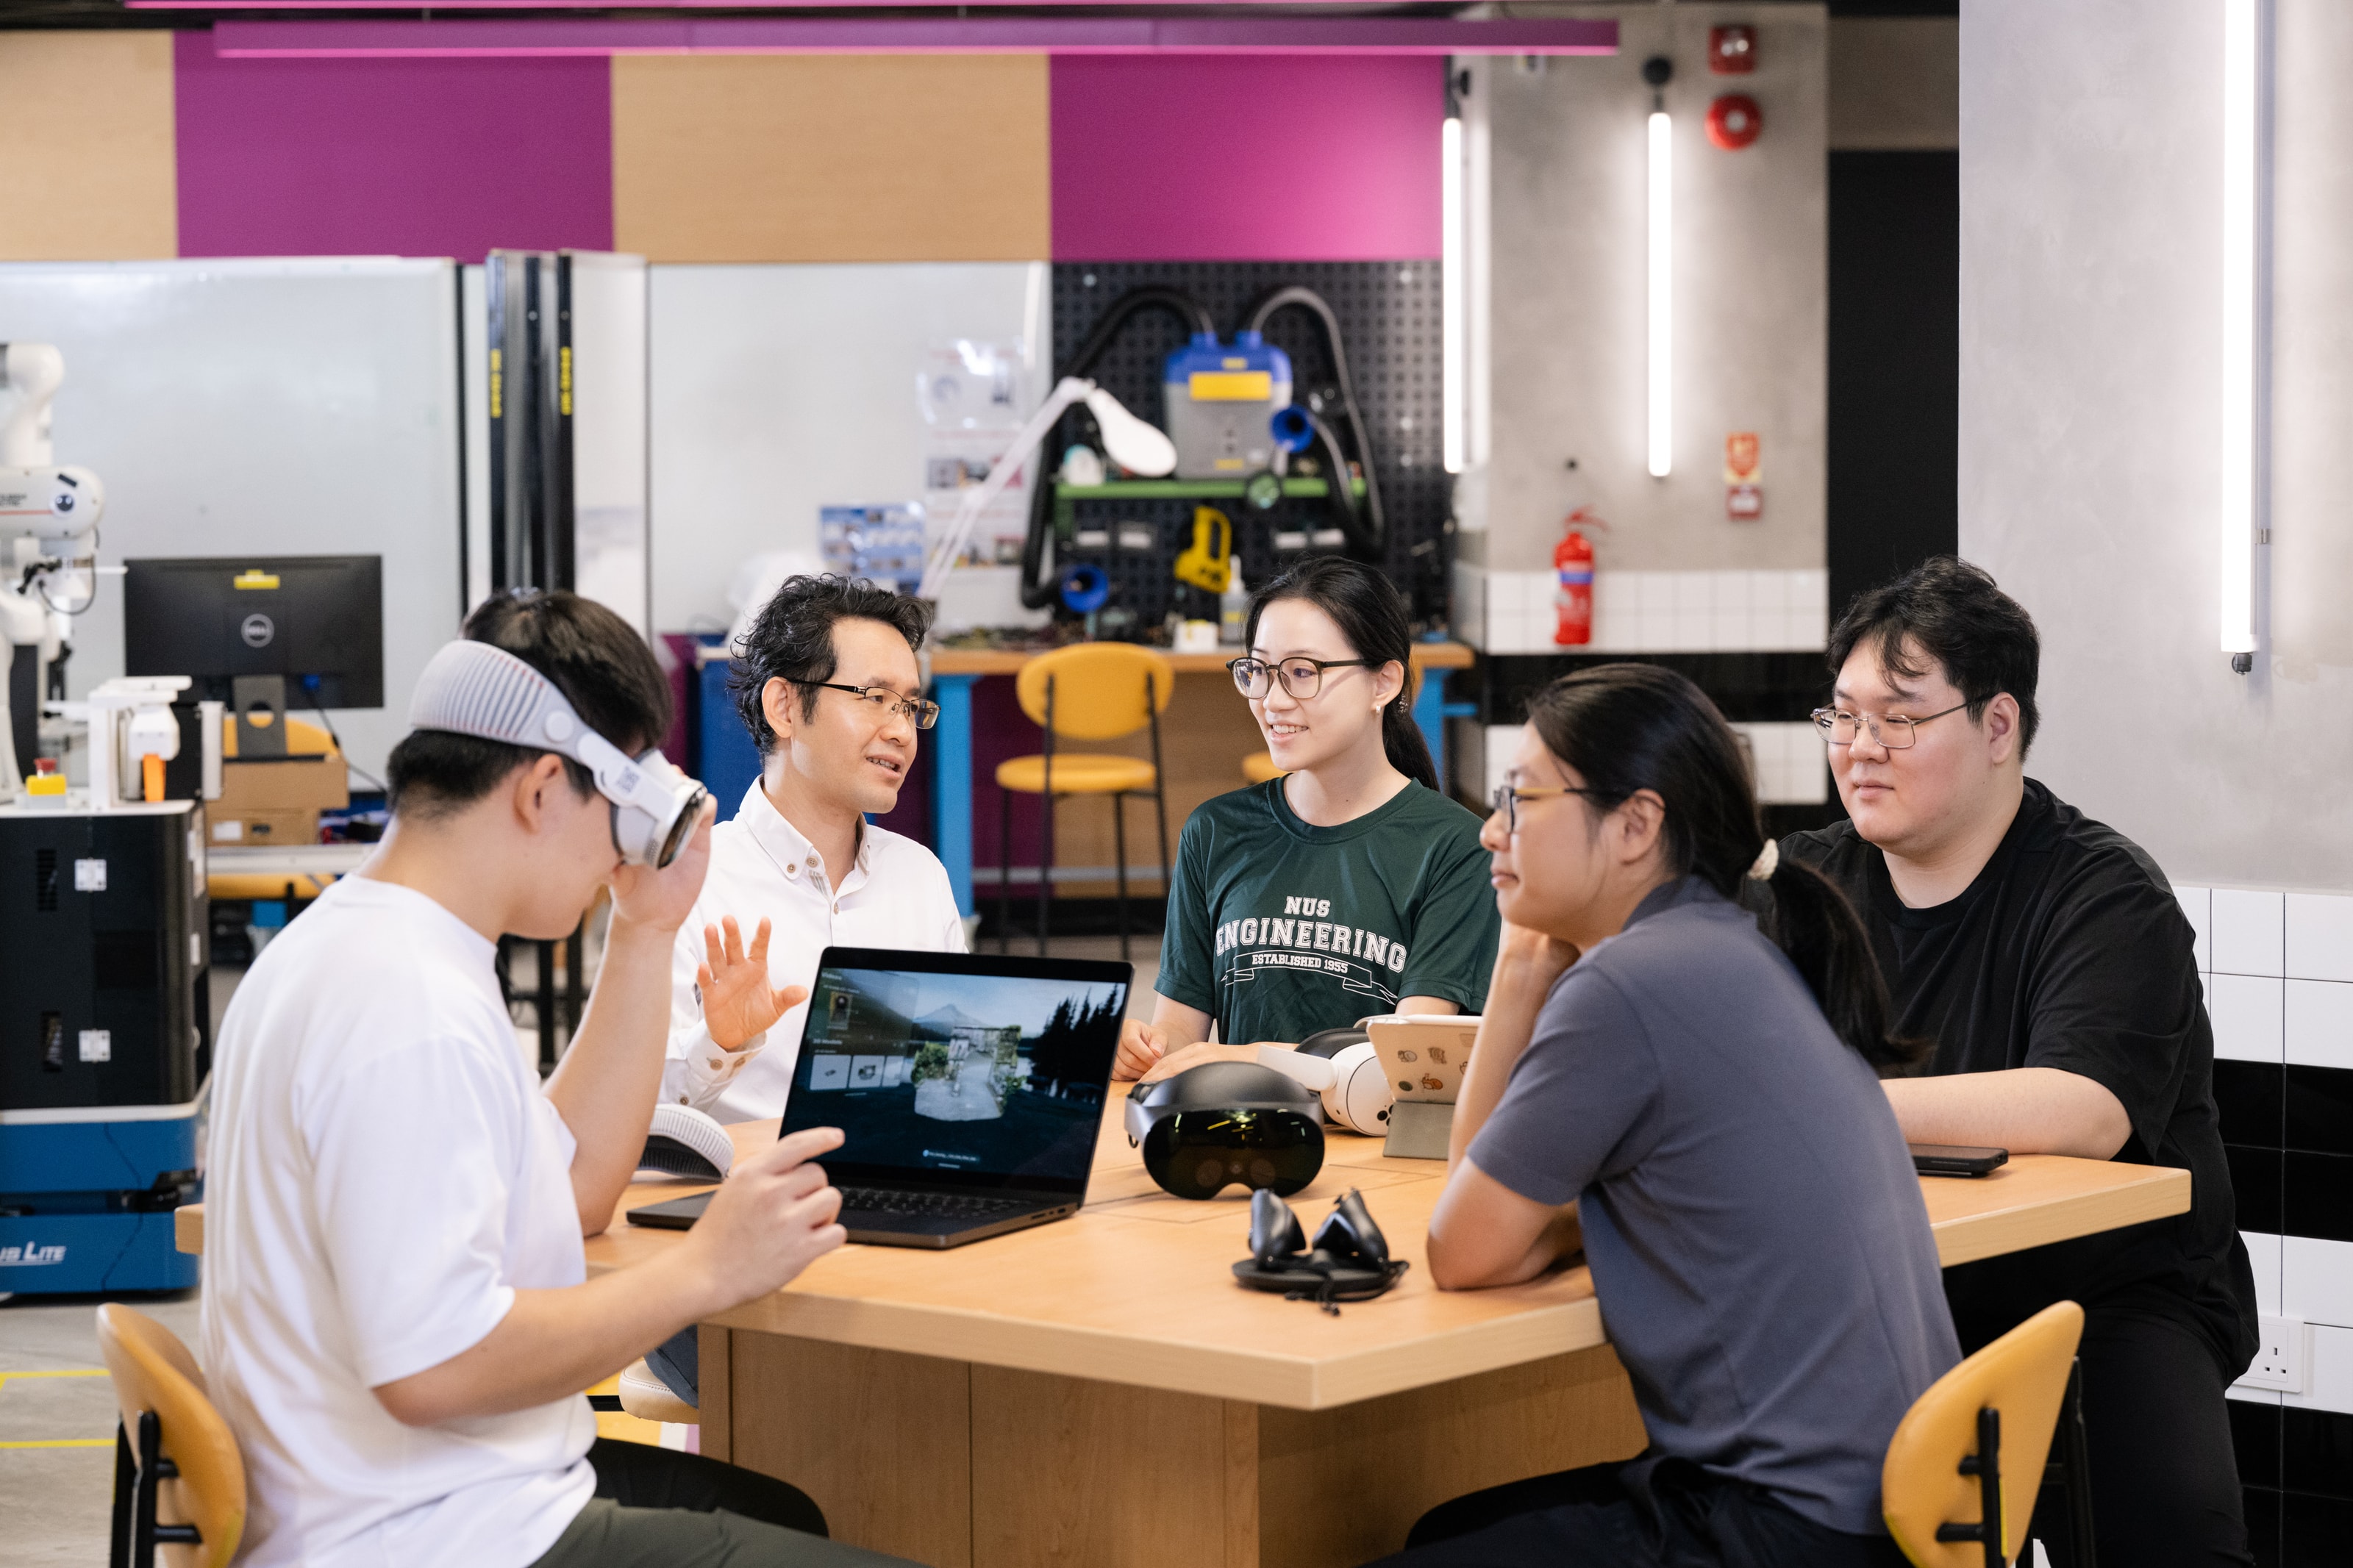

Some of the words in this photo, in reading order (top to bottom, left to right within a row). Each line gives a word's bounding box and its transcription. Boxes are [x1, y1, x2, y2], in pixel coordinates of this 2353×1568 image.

[1284, 896, 1330, 917] NUS
[1215, 917, 1407, 973] ENGINEERING
[1252, 953, 1322, 968] ESTABLISHED
[1324, 959, 1349, 973] 1955
